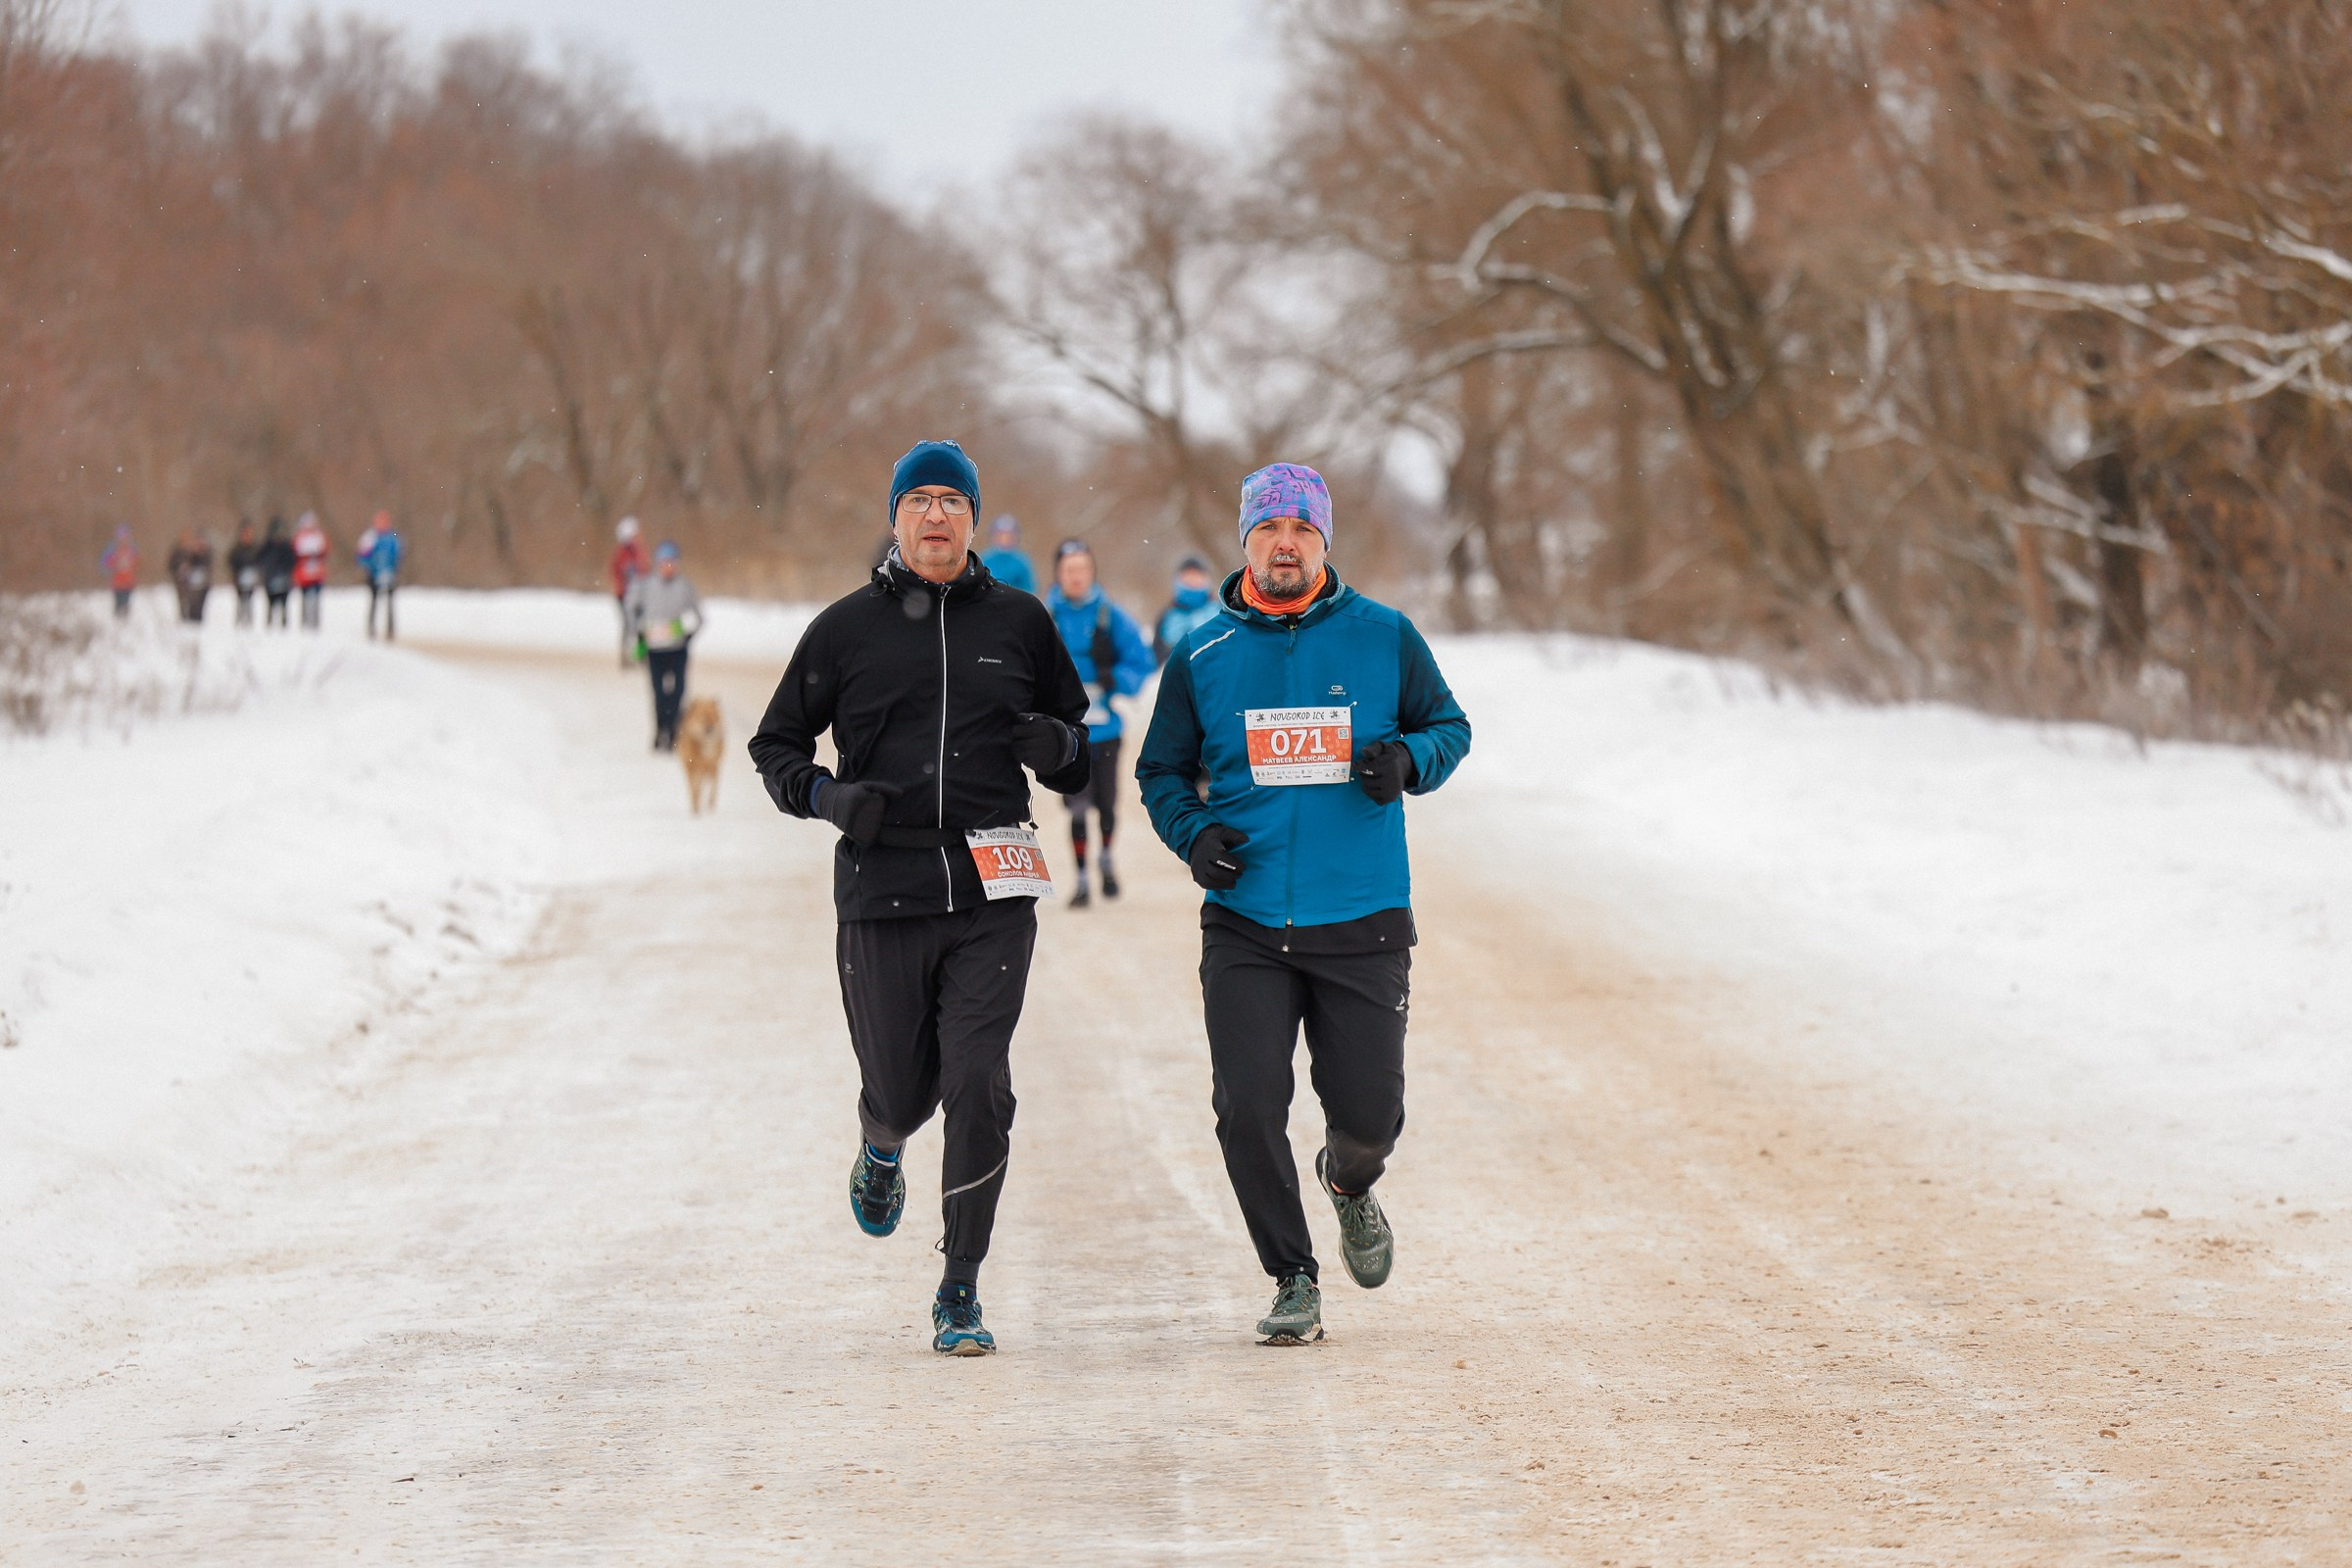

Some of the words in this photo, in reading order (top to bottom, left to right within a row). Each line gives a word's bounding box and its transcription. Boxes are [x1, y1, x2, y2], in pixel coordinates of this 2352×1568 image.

[1269, 711, 1311, 722] NOVGOROD
[1312, 710, 1325, 720] ICE
[1270, 728, 1327, 756] 071
[1262, 756, 1293, 764] МАТВЕЕВ
[1294, 754, 1337, 762] АЛЕКСАНДР
[992, 846, 1034, 871] 109
